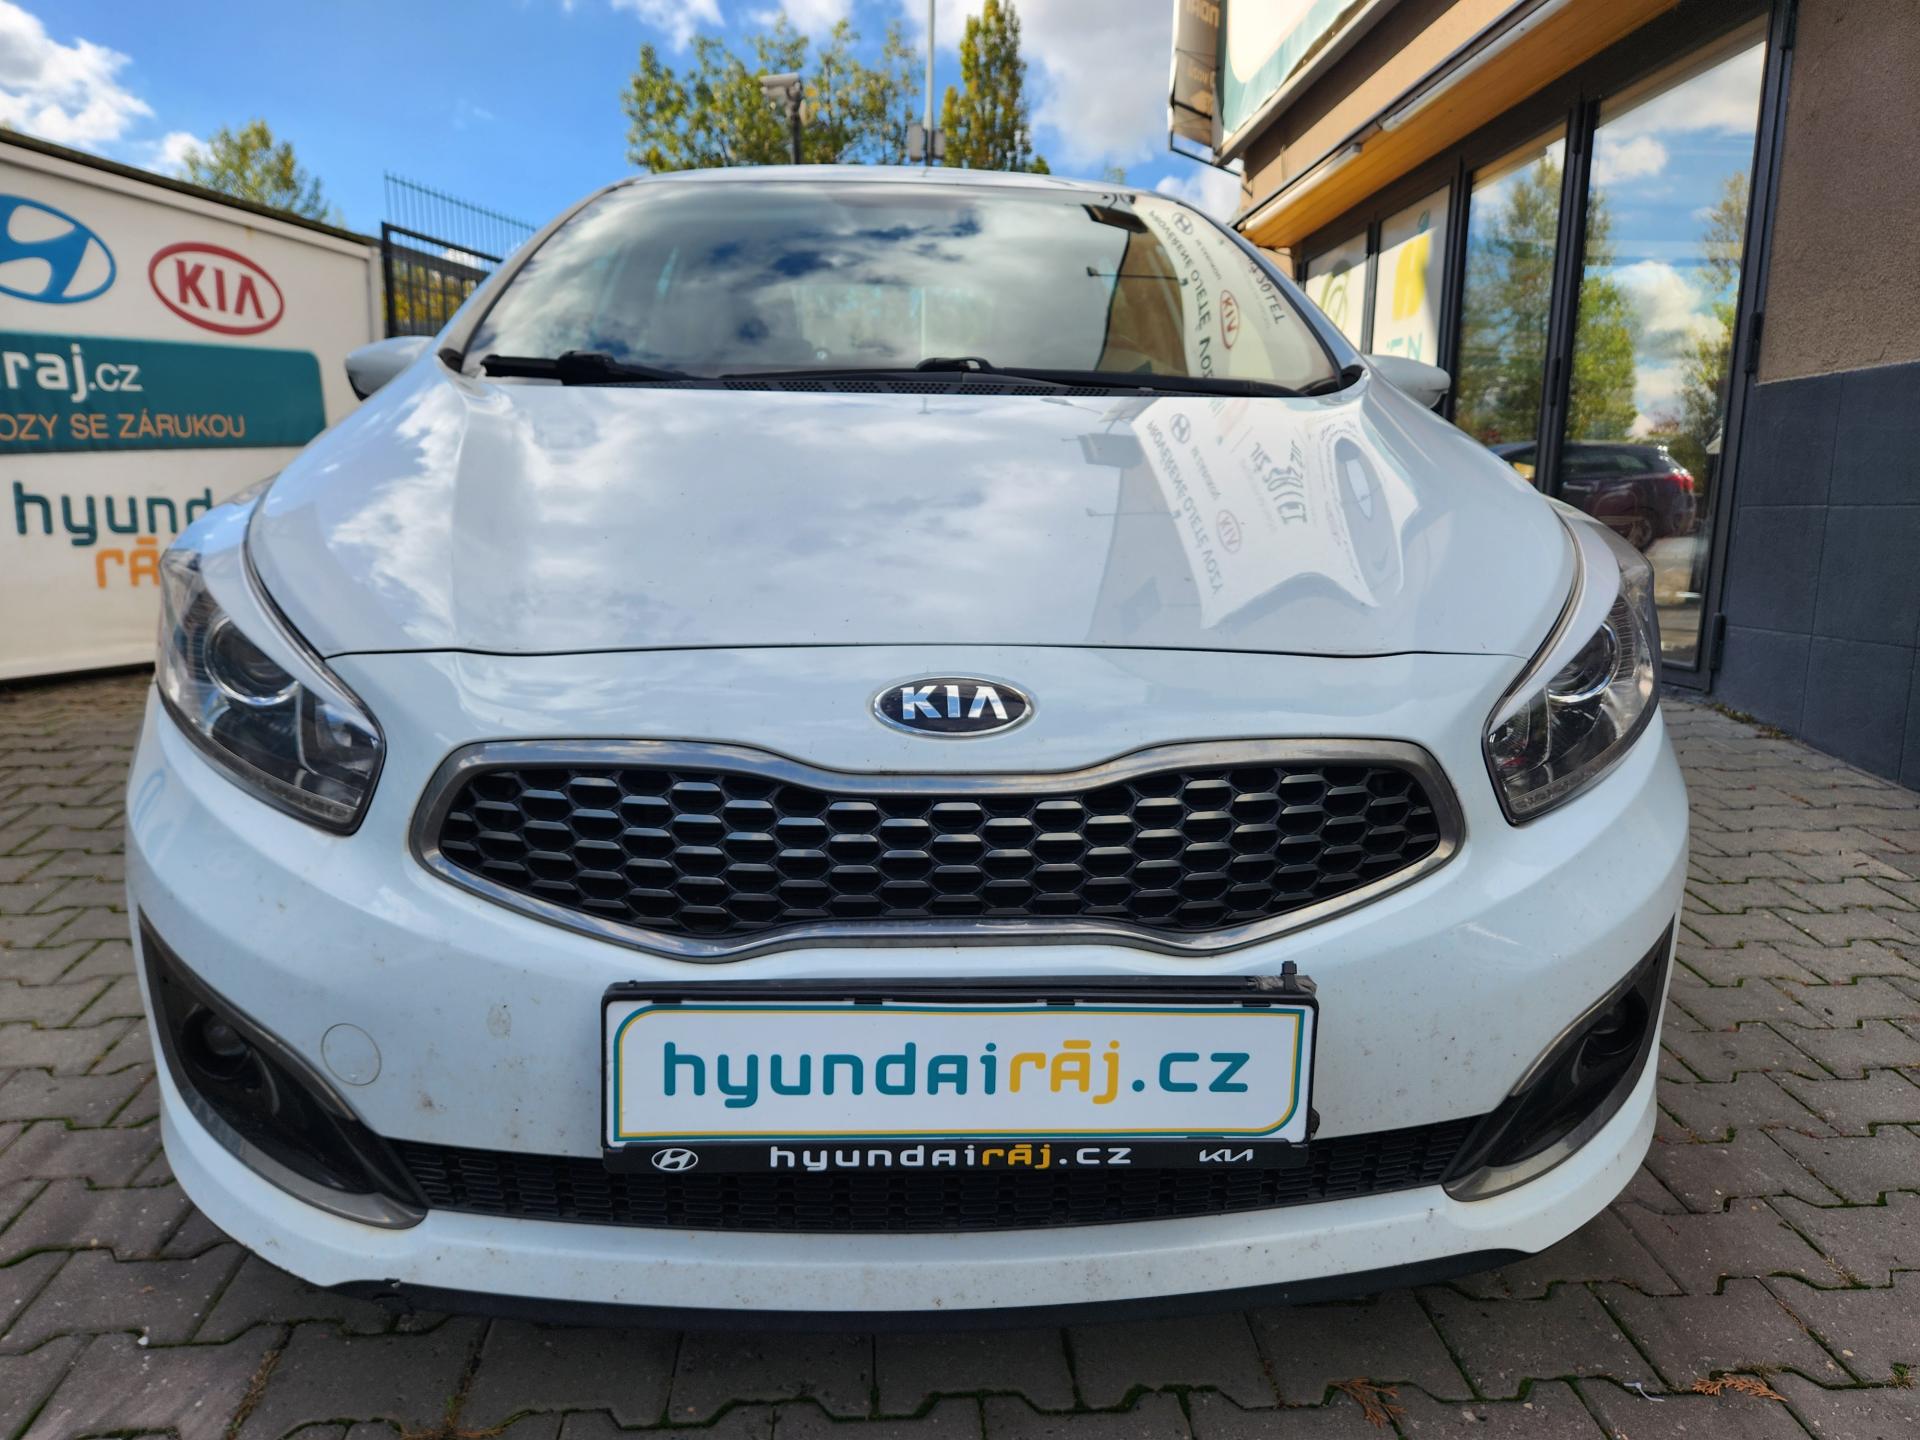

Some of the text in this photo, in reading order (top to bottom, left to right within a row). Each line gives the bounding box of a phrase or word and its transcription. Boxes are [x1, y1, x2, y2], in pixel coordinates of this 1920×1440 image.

[174, 257, 266, 320] KIA
[69, 413, 110, 440] SE
[117, 408, 246, 440] ZÁRUKOU
[900, 685, 1009, 720] KIA
